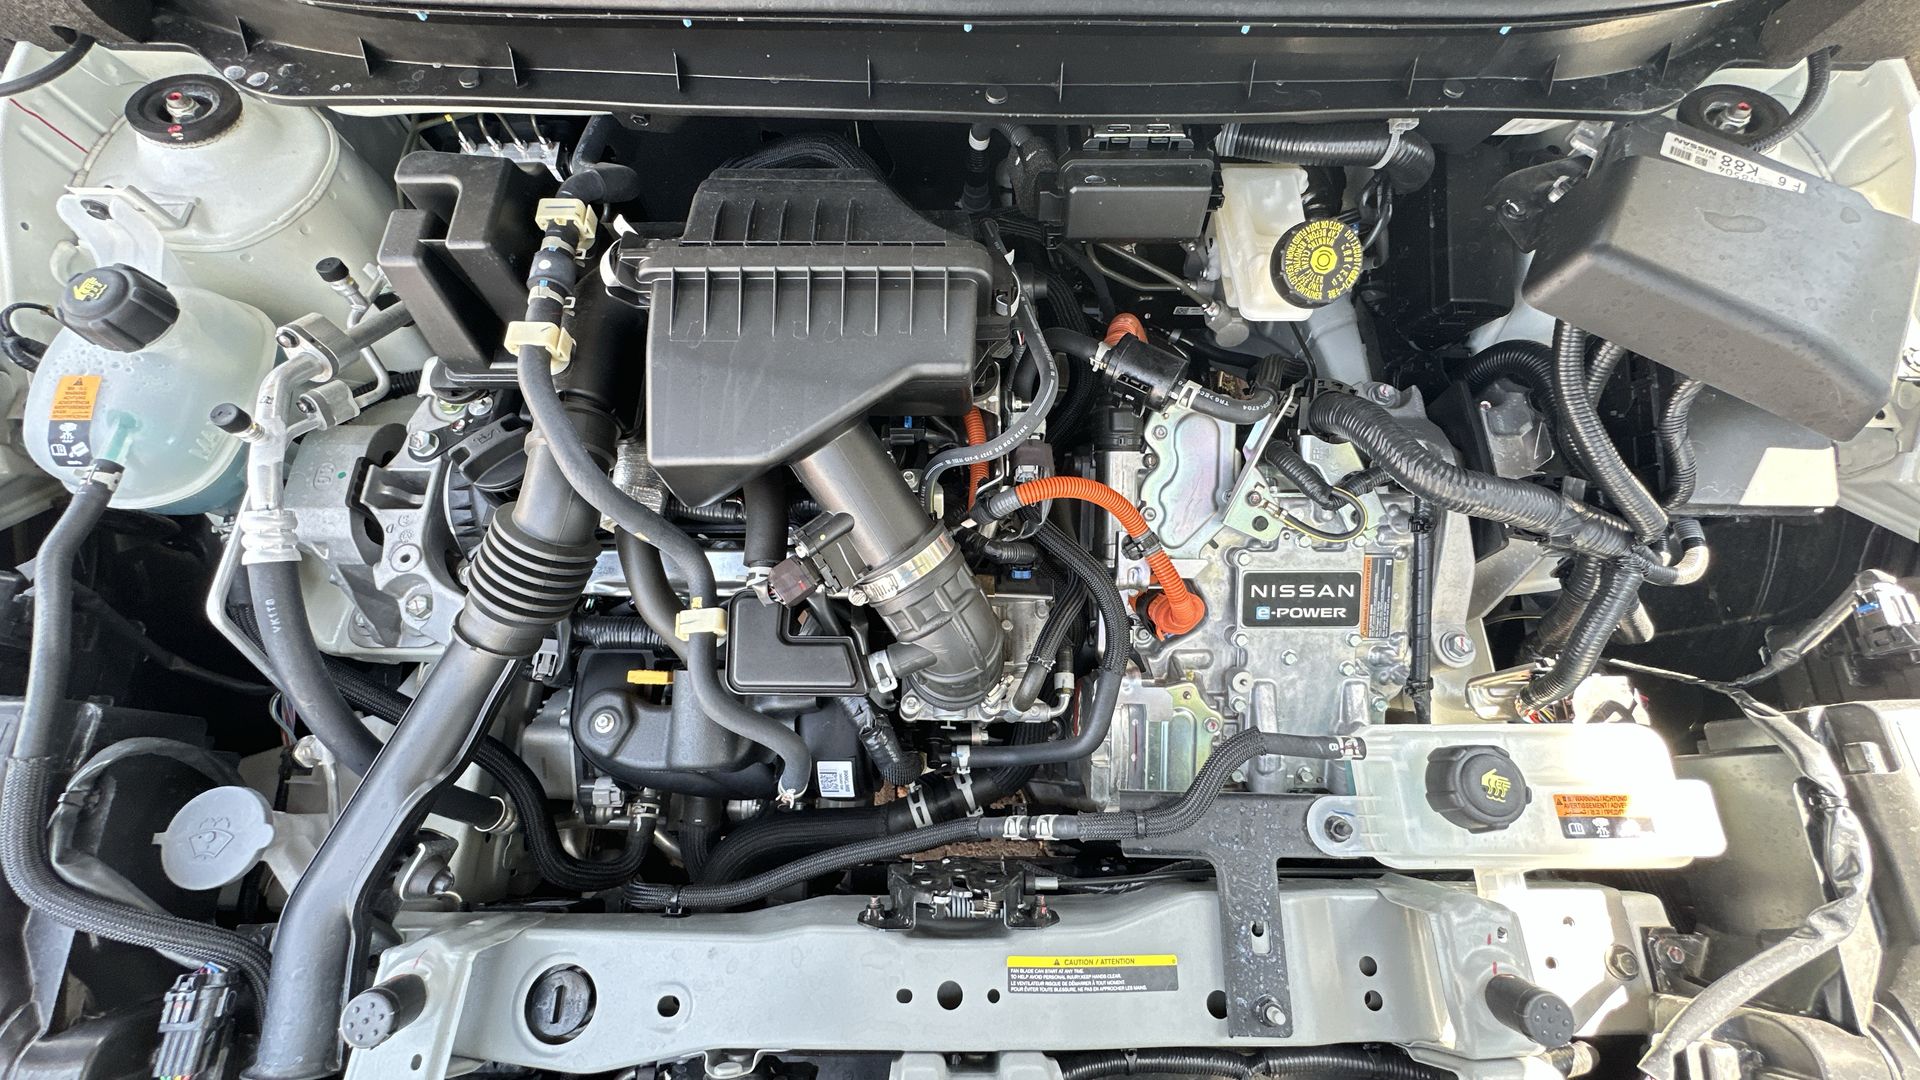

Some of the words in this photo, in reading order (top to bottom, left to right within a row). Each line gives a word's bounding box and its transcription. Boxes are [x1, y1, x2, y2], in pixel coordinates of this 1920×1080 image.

[1674, 138, 1717, 156] NISSAN
[1721, 154, 1759, 177] K88
[1320, 220, 1329, 228] OR
[1292, 228, 1307, 245] FLUID
[1285, 243, 1297, 260] FROM
[1285, 265, 1298, 285] SEALED
[1295, 283, 1322, 300] CONTAINER
[1014, 424, 1028, 439] KINK
[1250, 584, 1355, 598] NISSAN
[1256, 606, 1347, 620] e-POWER
[1064, 958, 1094, 966] CAUTION
